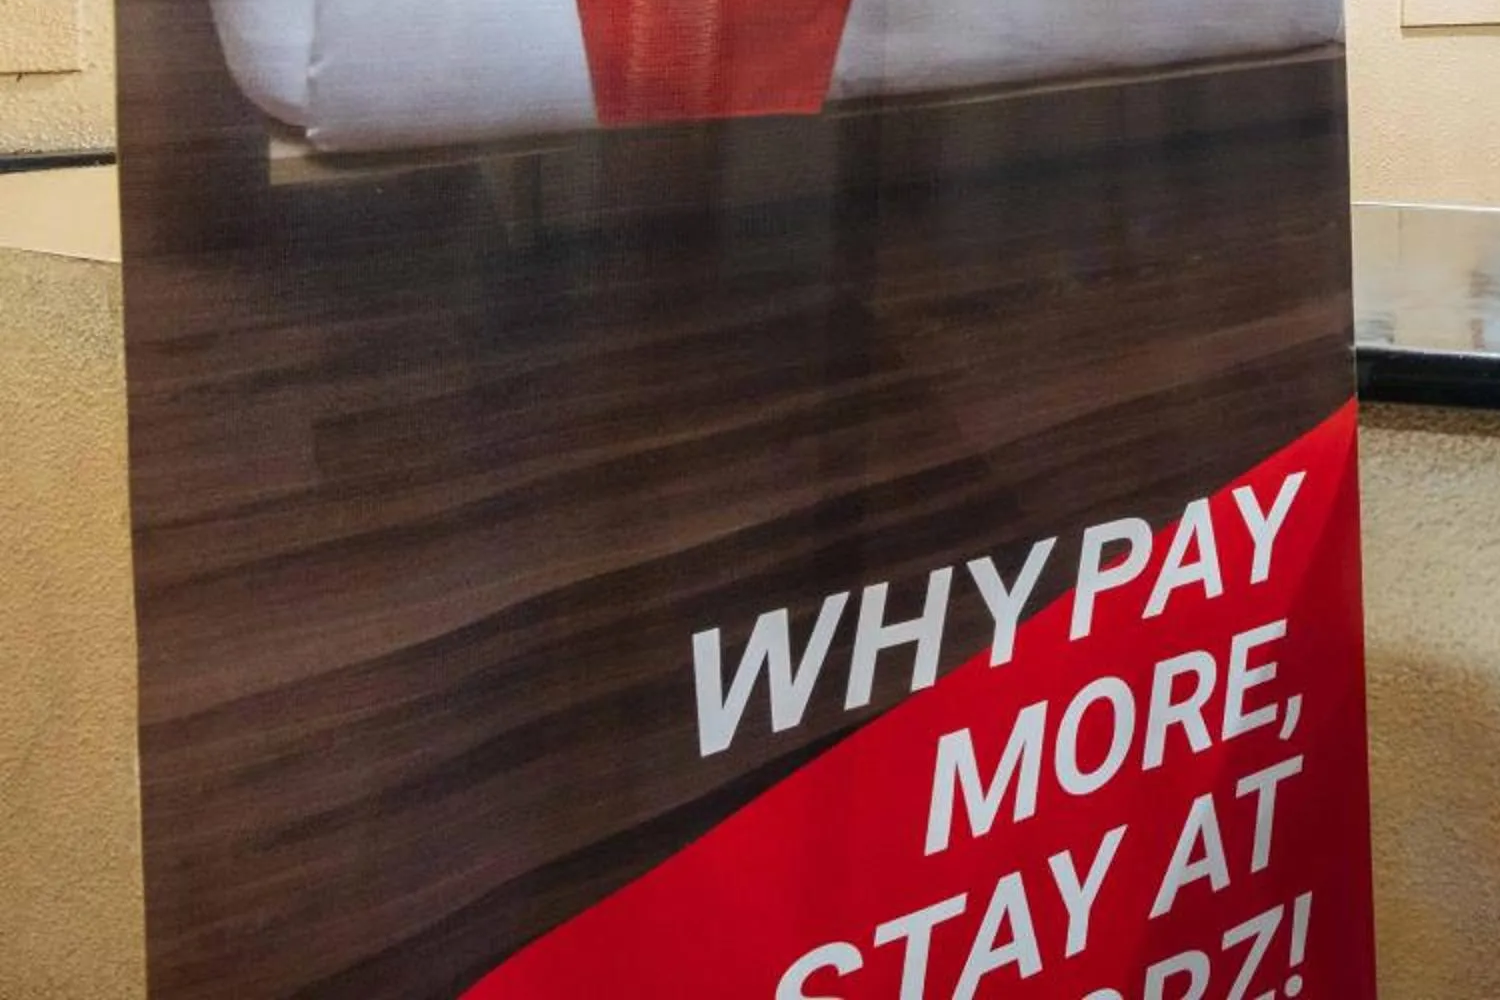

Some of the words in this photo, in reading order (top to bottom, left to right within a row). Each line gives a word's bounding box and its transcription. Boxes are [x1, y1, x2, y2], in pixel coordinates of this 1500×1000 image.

[692, 536, 1057, 758] WHY
[1069, 471, 1307, 642] PAY
[924, 619, 1302, 857] MORE,
[1148, 755, 1304, 920] AT
